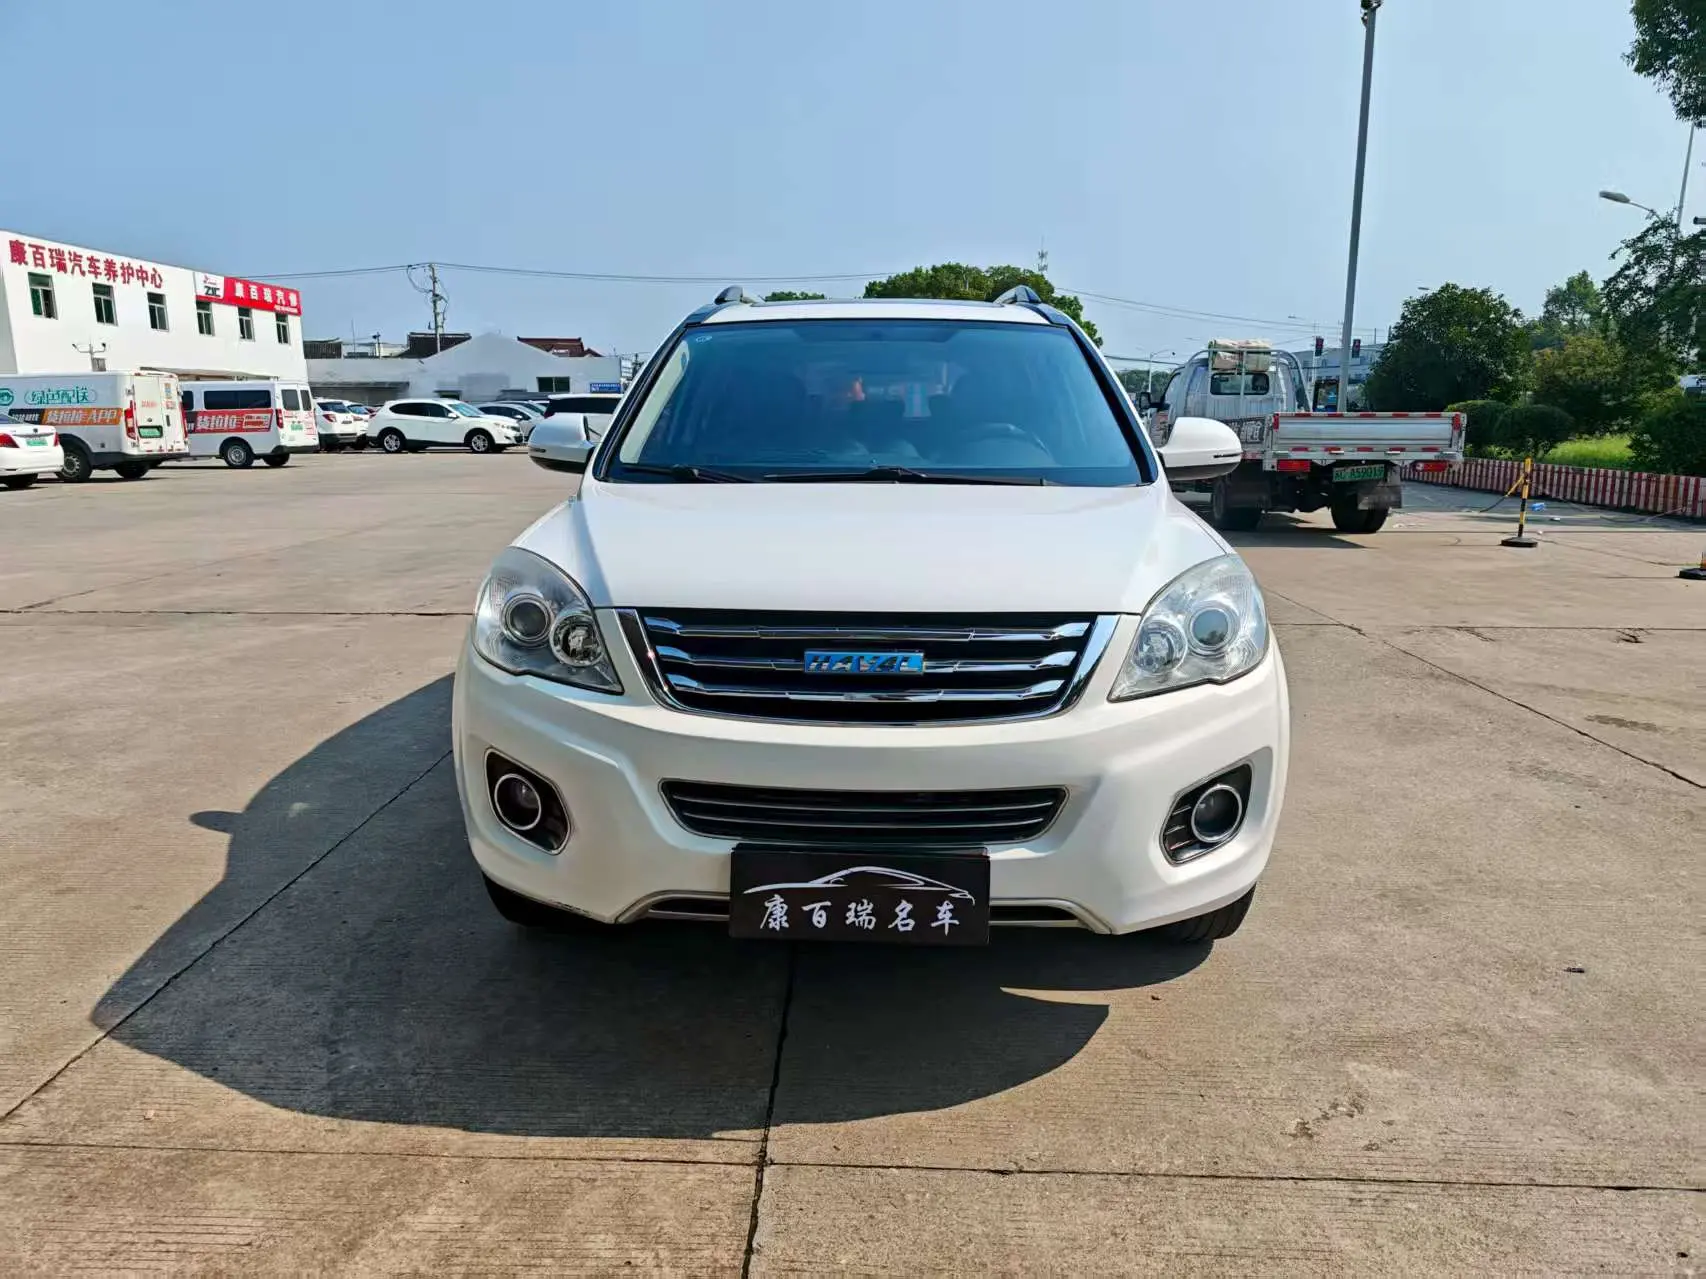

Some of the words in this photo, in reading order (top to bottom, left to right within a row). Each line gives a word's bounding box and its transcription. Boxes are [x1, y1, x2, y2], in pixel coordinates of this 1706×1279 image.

[9, 239, 163, 289] 康百瑞汽车养护中心
[808, 655, 920, 673] HAVAL
[760, 894, 960, 936] 康百瑞名车
